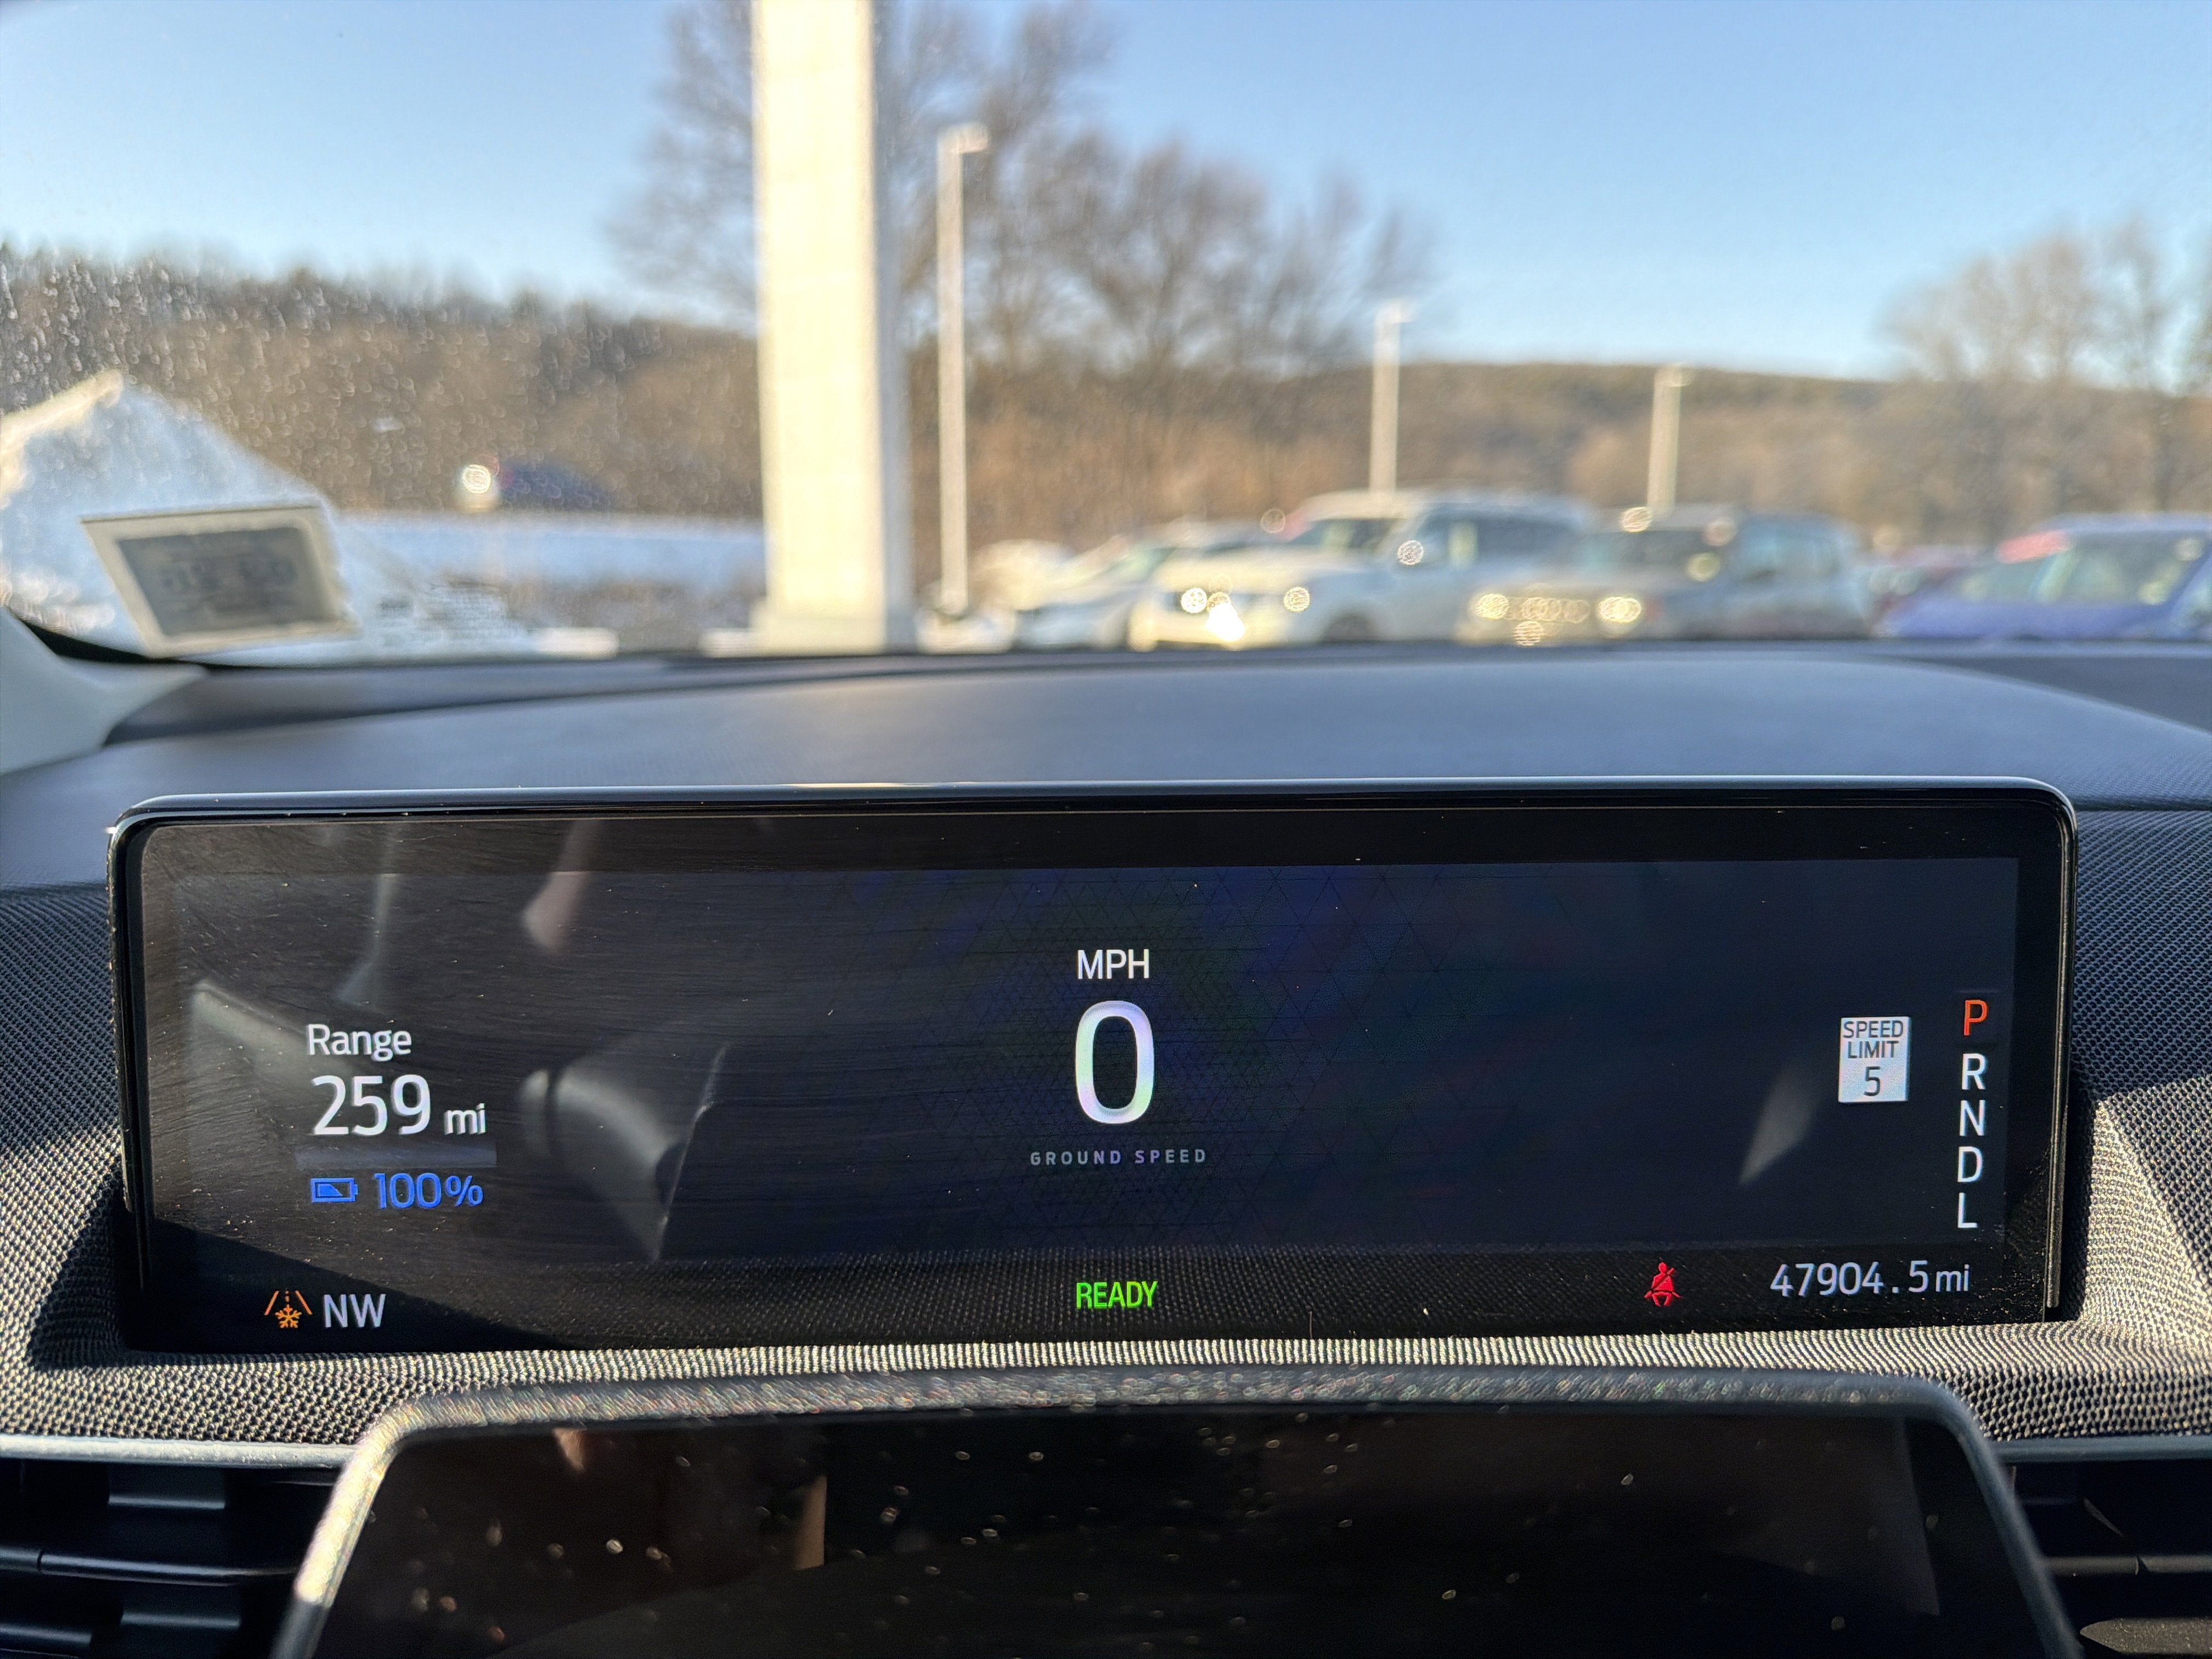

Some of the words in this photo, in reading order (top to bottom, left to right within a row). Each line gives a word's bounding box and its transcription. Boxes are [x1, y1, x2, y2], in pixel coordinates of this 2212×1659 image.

[1077, 949, 1150, 980] MPH
[1842, 1020, 1904, 1039] SPEED
[1963, 1000, 1988, 1036] P
[307, 1024, 413, 1062] Range
[1847, 1041, 1899, 1059] LIMIT
[1075, 1000, 1155, 1125] 0
[1961, 1053, 1987, 1090] R
[1863, 1066, 1882, 1097] 5
[312, 1074, 432, 1137] 259
[444, 1102, 487, 1135] mi
[1959, 1099, 1986, 1136] N
[1030, 1150, 1122, 1166] GROUND
[1135, 1148, 1206, 1164] SPEED
[1956, 1146, 1983, 1183] D
[374, 1172, 484, 1209] 100%
[1957, 1192, 1978, 1228] L
[323, 1294, 386, 1328] NW
[1075, 1281, 1158, 1310] READY
